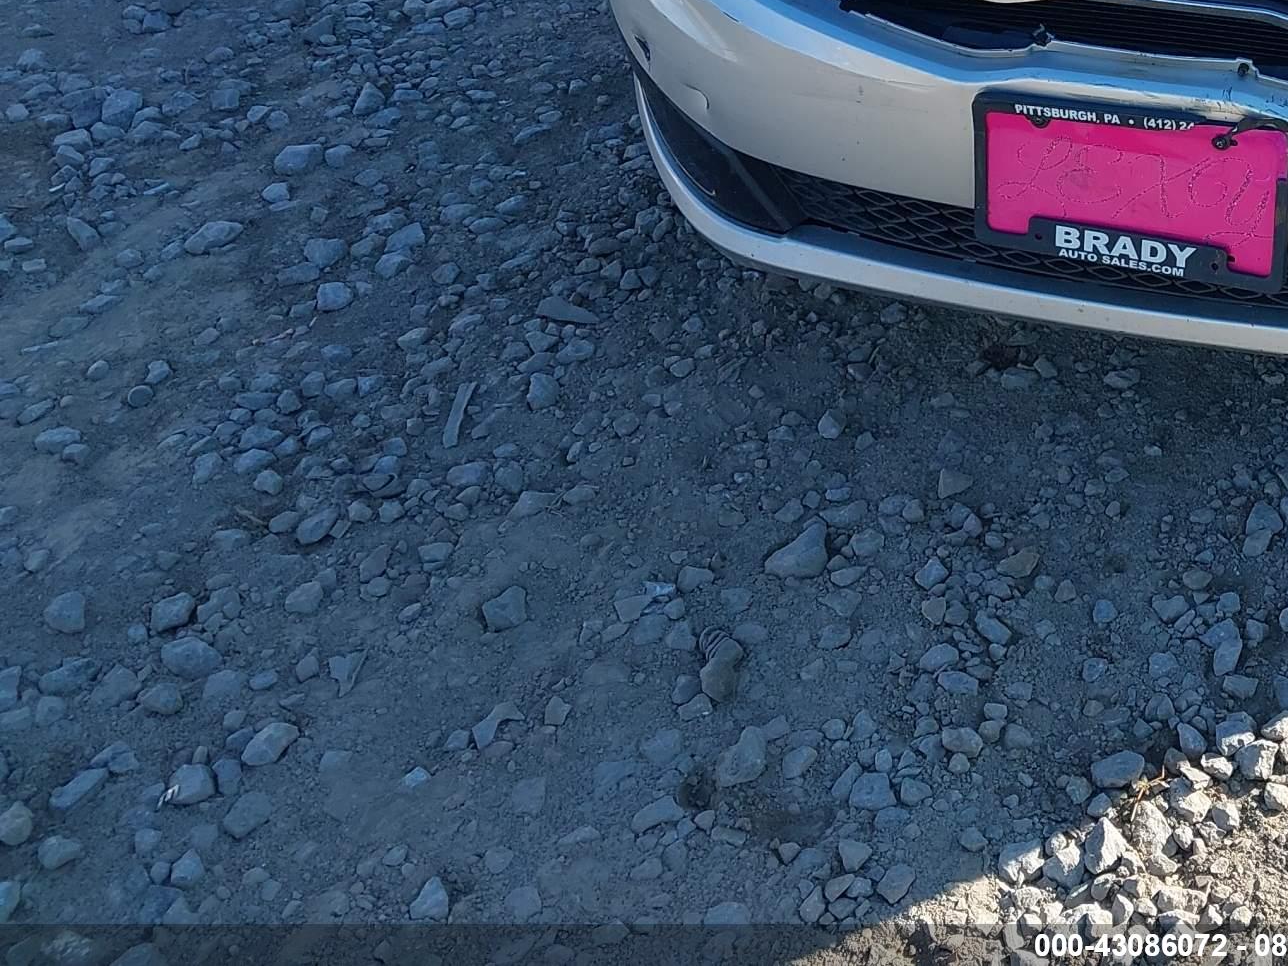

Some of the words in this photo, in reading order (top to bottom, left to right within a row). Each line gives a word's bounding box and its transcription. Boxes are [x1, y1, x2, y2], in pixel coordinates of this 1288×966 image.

[1014, 104, 1100, 125] PITTSBURGH,
[1103, 112, 1121, 126] PA
[1143, 117, 1177, 131] (412)
[1054, 225, 1198, 269] BRADY
[1058, 247, 1097, 263] AUTO
[1101, 255, 1184, 277] SALES.COM
